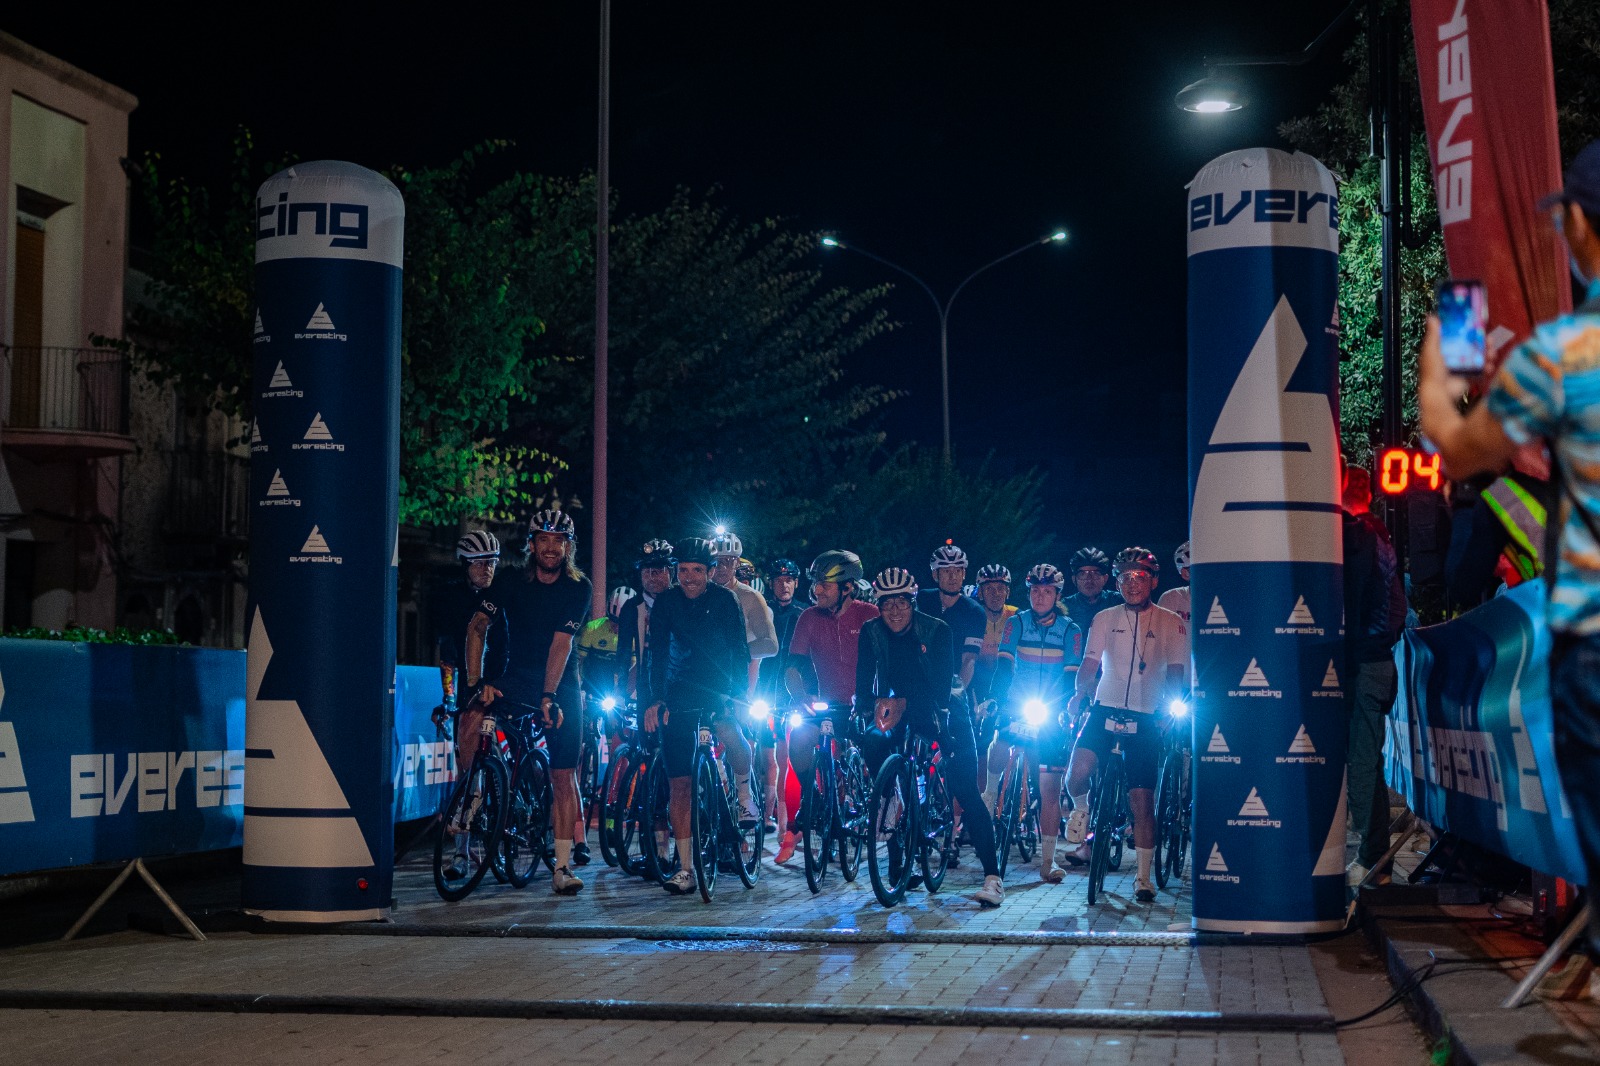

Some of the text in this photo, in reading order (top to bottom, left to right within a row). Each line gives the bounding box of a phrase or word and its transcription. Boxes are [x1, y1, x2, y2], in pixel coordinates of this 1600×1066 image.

[294, 332, 347, 342] everesting
[262, 389, 304, 398] everesting
[292, 442, 345, 451] everesting
[1381, 449, 1441, 493] 04
[259, 498, 301, 507] everesting
[289, 555, 342, 565] everesting
[1199, 627, 1241, 636] everesting
[1275, 626, 1325, 636] everesting
[1227, 689, 1282, 699] everesting
[1201, 755, 1241, 764] everesting
[1275, 756, 1326, 765] everesting
[1227, 818, 1282, 828] everesting
[1199, 874, 1240, 884] everesting
